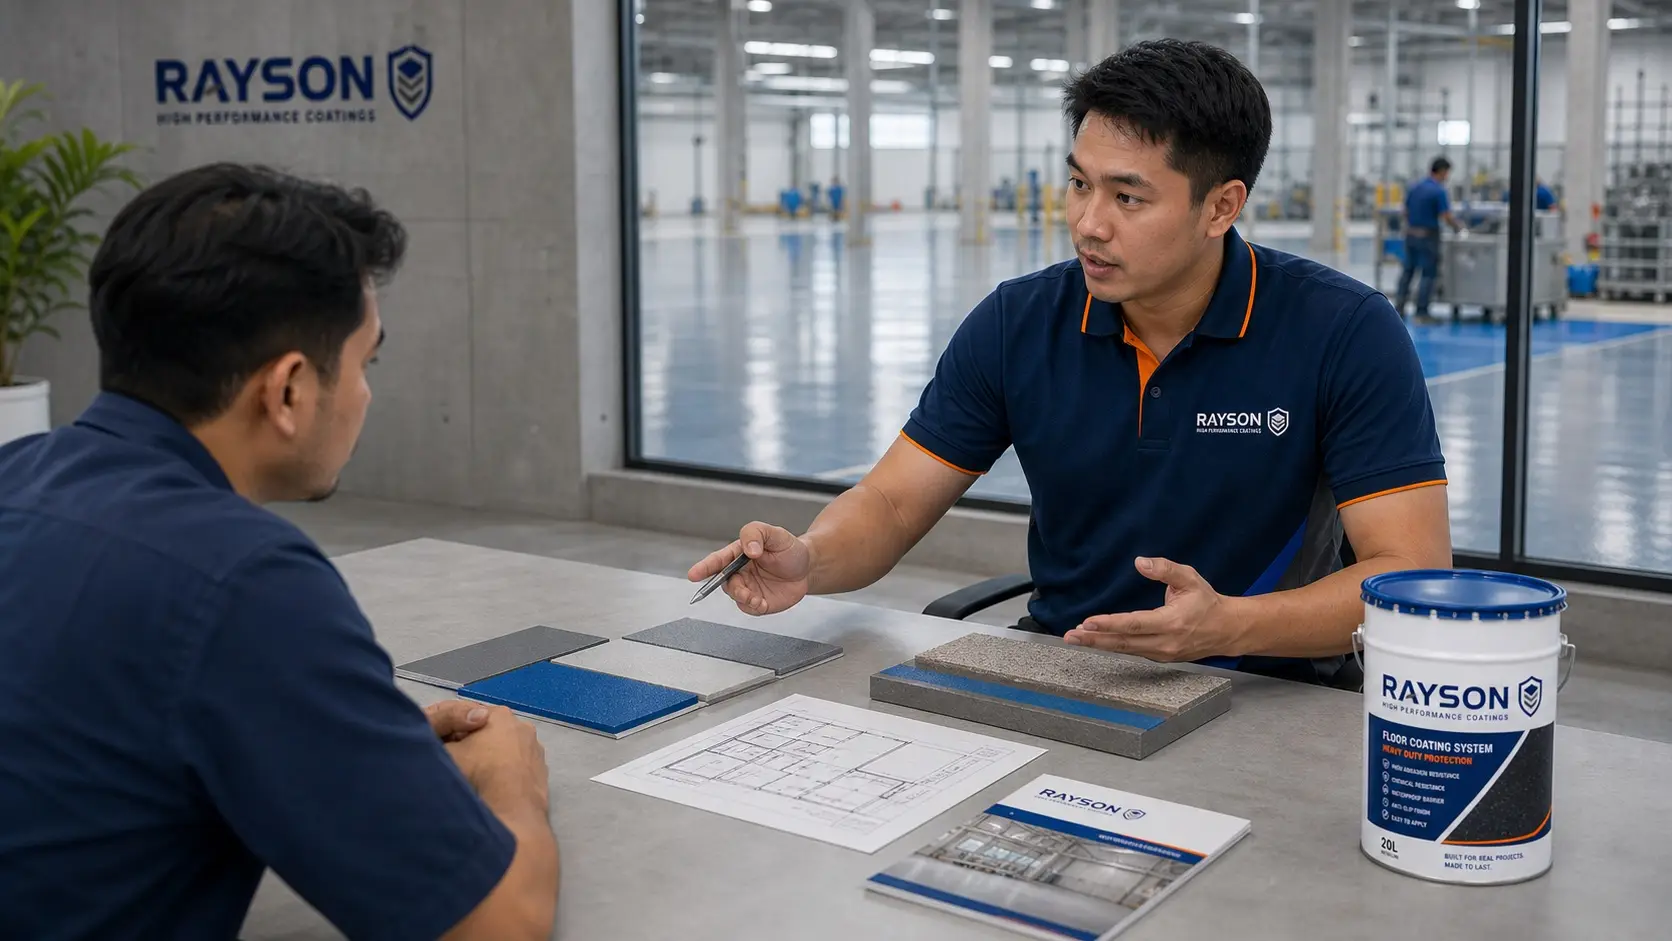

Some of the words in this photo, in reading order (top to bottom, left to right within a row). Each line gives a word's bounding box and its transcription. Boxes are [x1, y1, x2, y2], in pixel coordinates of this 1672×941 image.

[155, 56, 374, 104] RAYSON
[156, 112, 192, 125] HIGH
[196, 110, 300, 125] PERFORMANCE
[305, 109, 376, 123] COATINGS
[1196, 412, 1262, 427] RAYSON
[1382, 673, 1509, 710] RAYSON
[1382, 701, 1398, 711] HIGH
[1400, 706, 1463, 721] PERFORMANCE
[1382, 730, 1408, 746] FLOOR
[1409, 737, 1452, 753] COATING
[1453, 742, 1493, 754] SYSTEM
[1424, 755, 1473, 766] PROTECTION
[1039, 788, 1122, 814] RAYSON
[1380, 837, 1399, 853] 20L
[1444, 853, 1462, 861] BUILT
[1444, 861, 1463, 869] MADE
